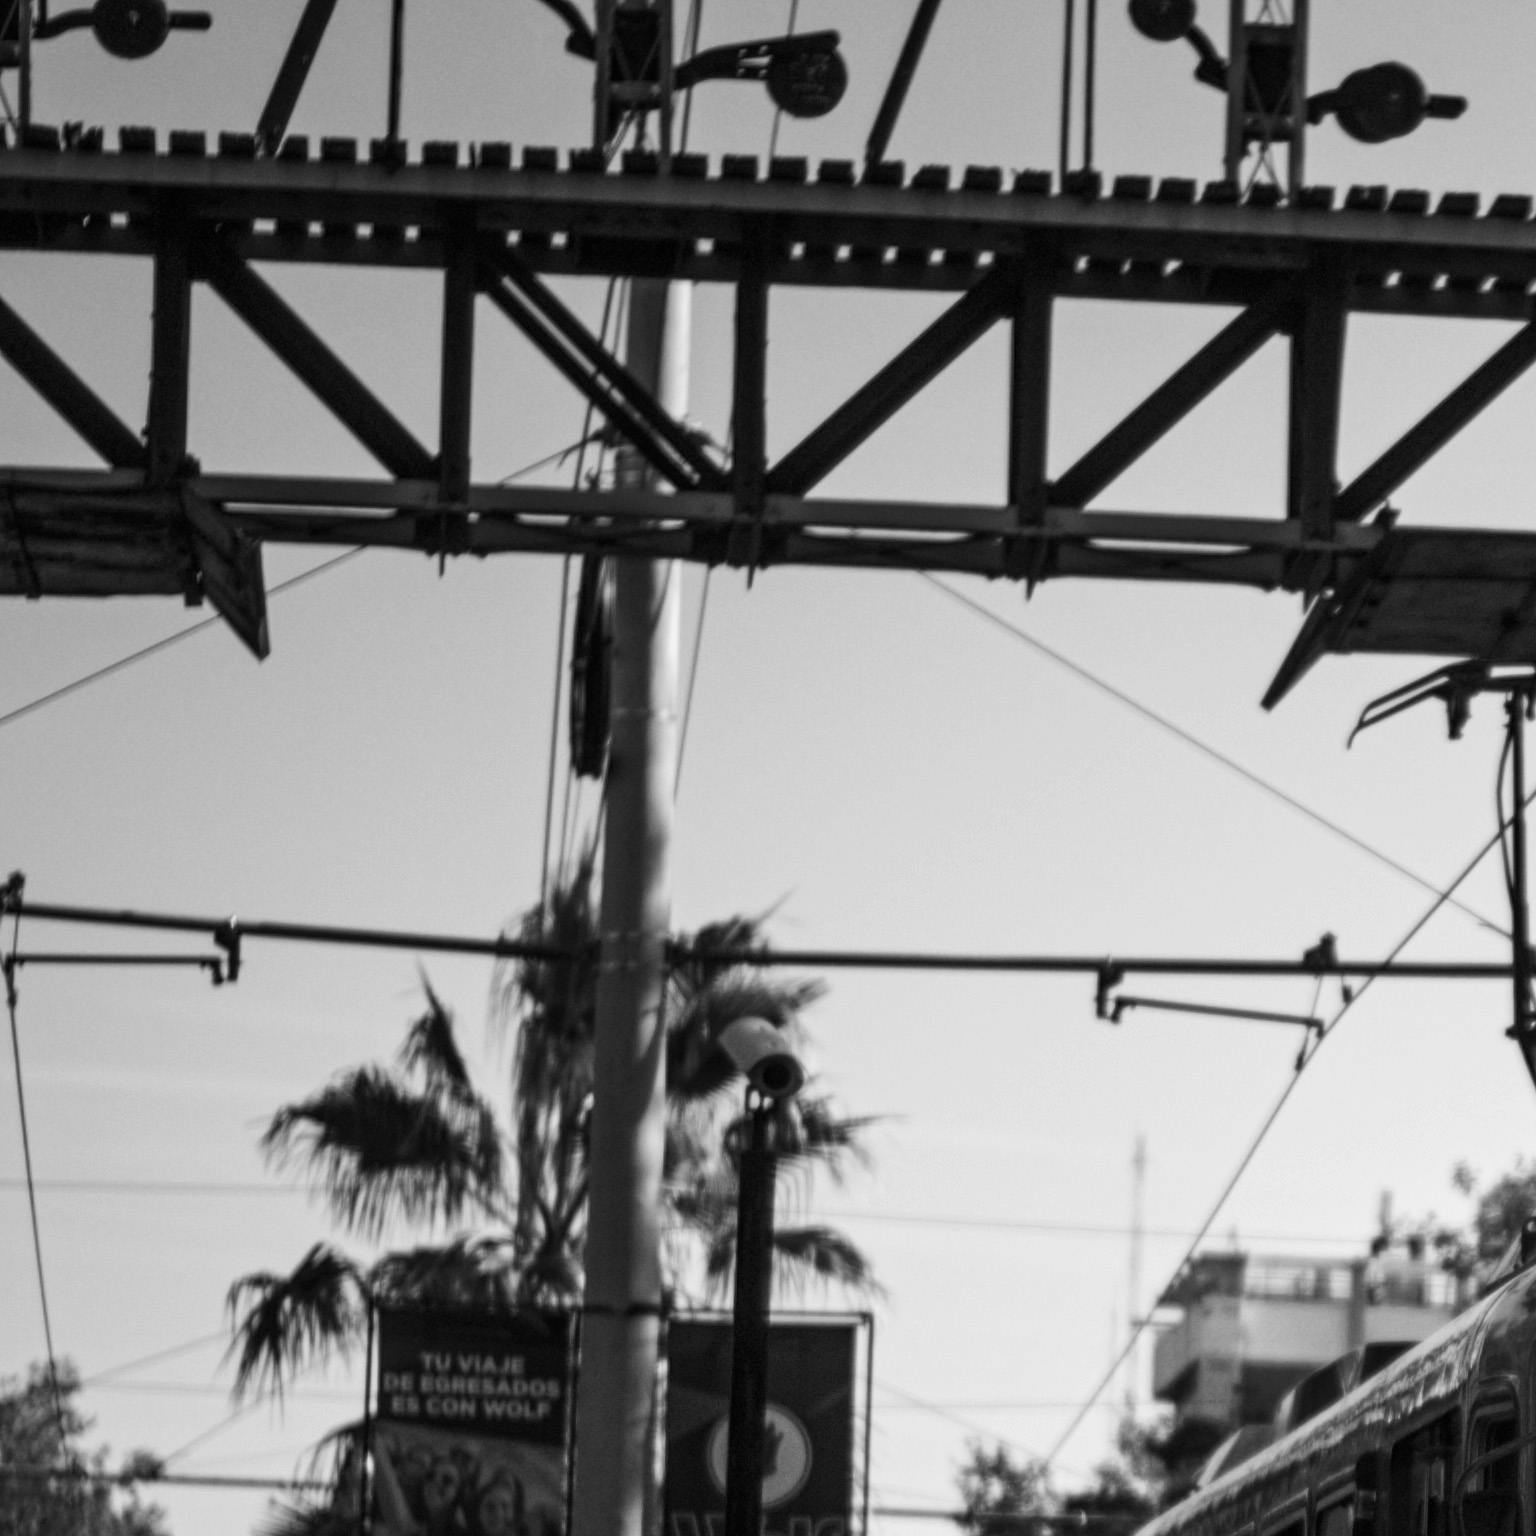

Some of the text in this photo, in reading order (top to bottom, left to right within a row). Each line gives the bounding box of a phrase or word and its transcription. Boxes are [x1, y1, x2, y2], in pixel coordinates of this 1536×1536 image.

[420, 1351, 525, 1376] TU VIAJE
[383, 1371, 561, 1399] DE EGRESADOS
[425, 1396, 476, 1418] CON
[482, 1397, 551, 1421] WOLF
